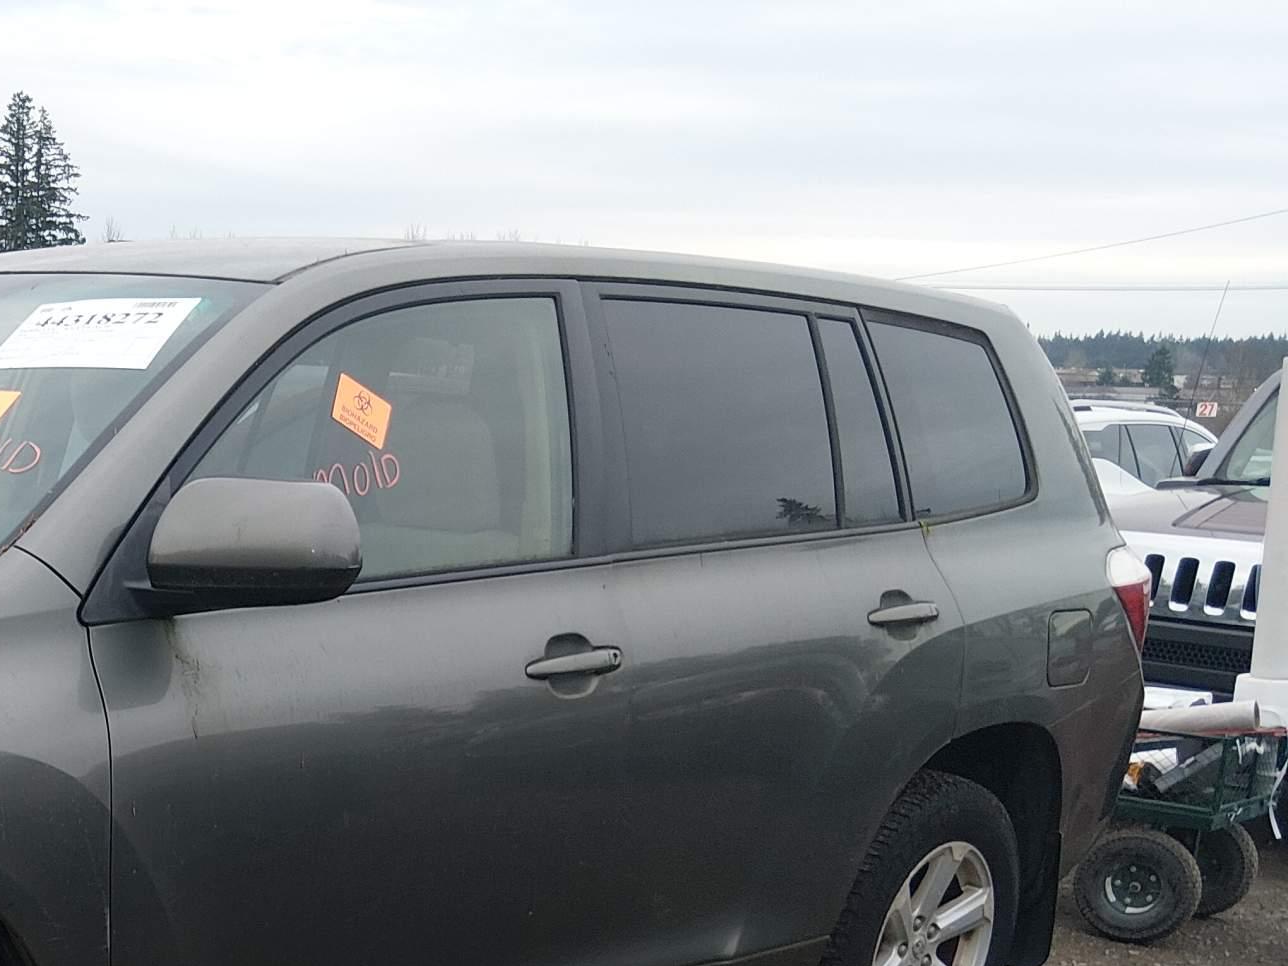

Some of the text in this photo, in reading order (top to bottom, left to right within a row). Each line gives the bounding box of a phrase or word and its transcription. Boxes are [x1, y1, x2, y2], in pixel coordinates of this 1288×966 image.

[35, 311, 164, 328] 44318272
[1198, 403, 1215, 417] 27
[341, 405, 378, 434] BIOHAZARD
